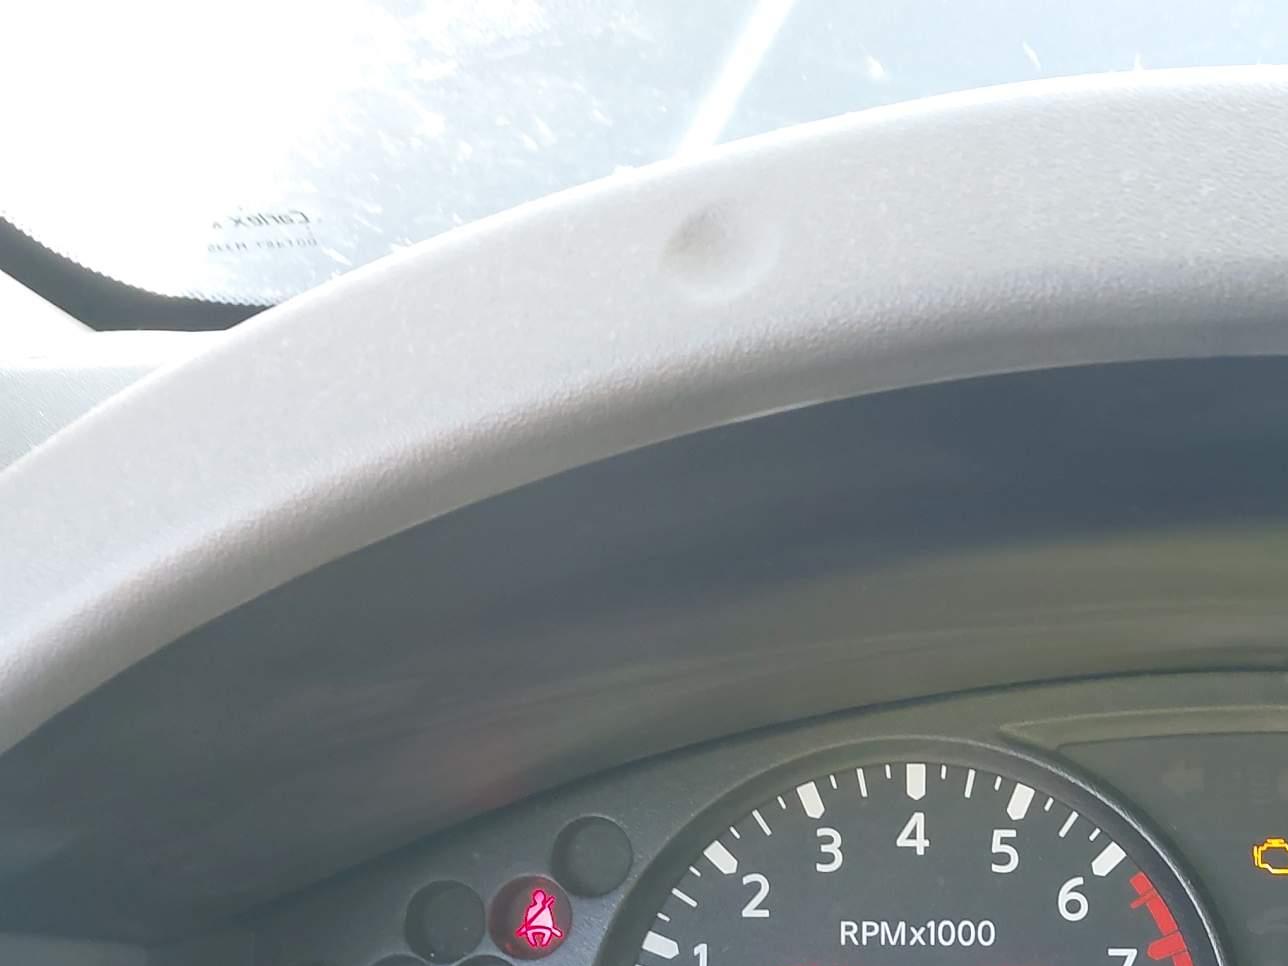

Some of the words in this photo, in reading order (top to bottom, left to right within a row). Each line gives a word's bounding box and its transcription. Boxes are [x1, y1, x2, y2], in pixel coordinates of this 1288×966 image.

[815, 828, 844, 873] 3
[896, 812, 930, 855] 4
[991, 829, 1019, 874] 5
[741, 874, 770, 918] 2
[1058, 877, 1089, 921] 6
[839, 920, 996, 947] RPMx1000
